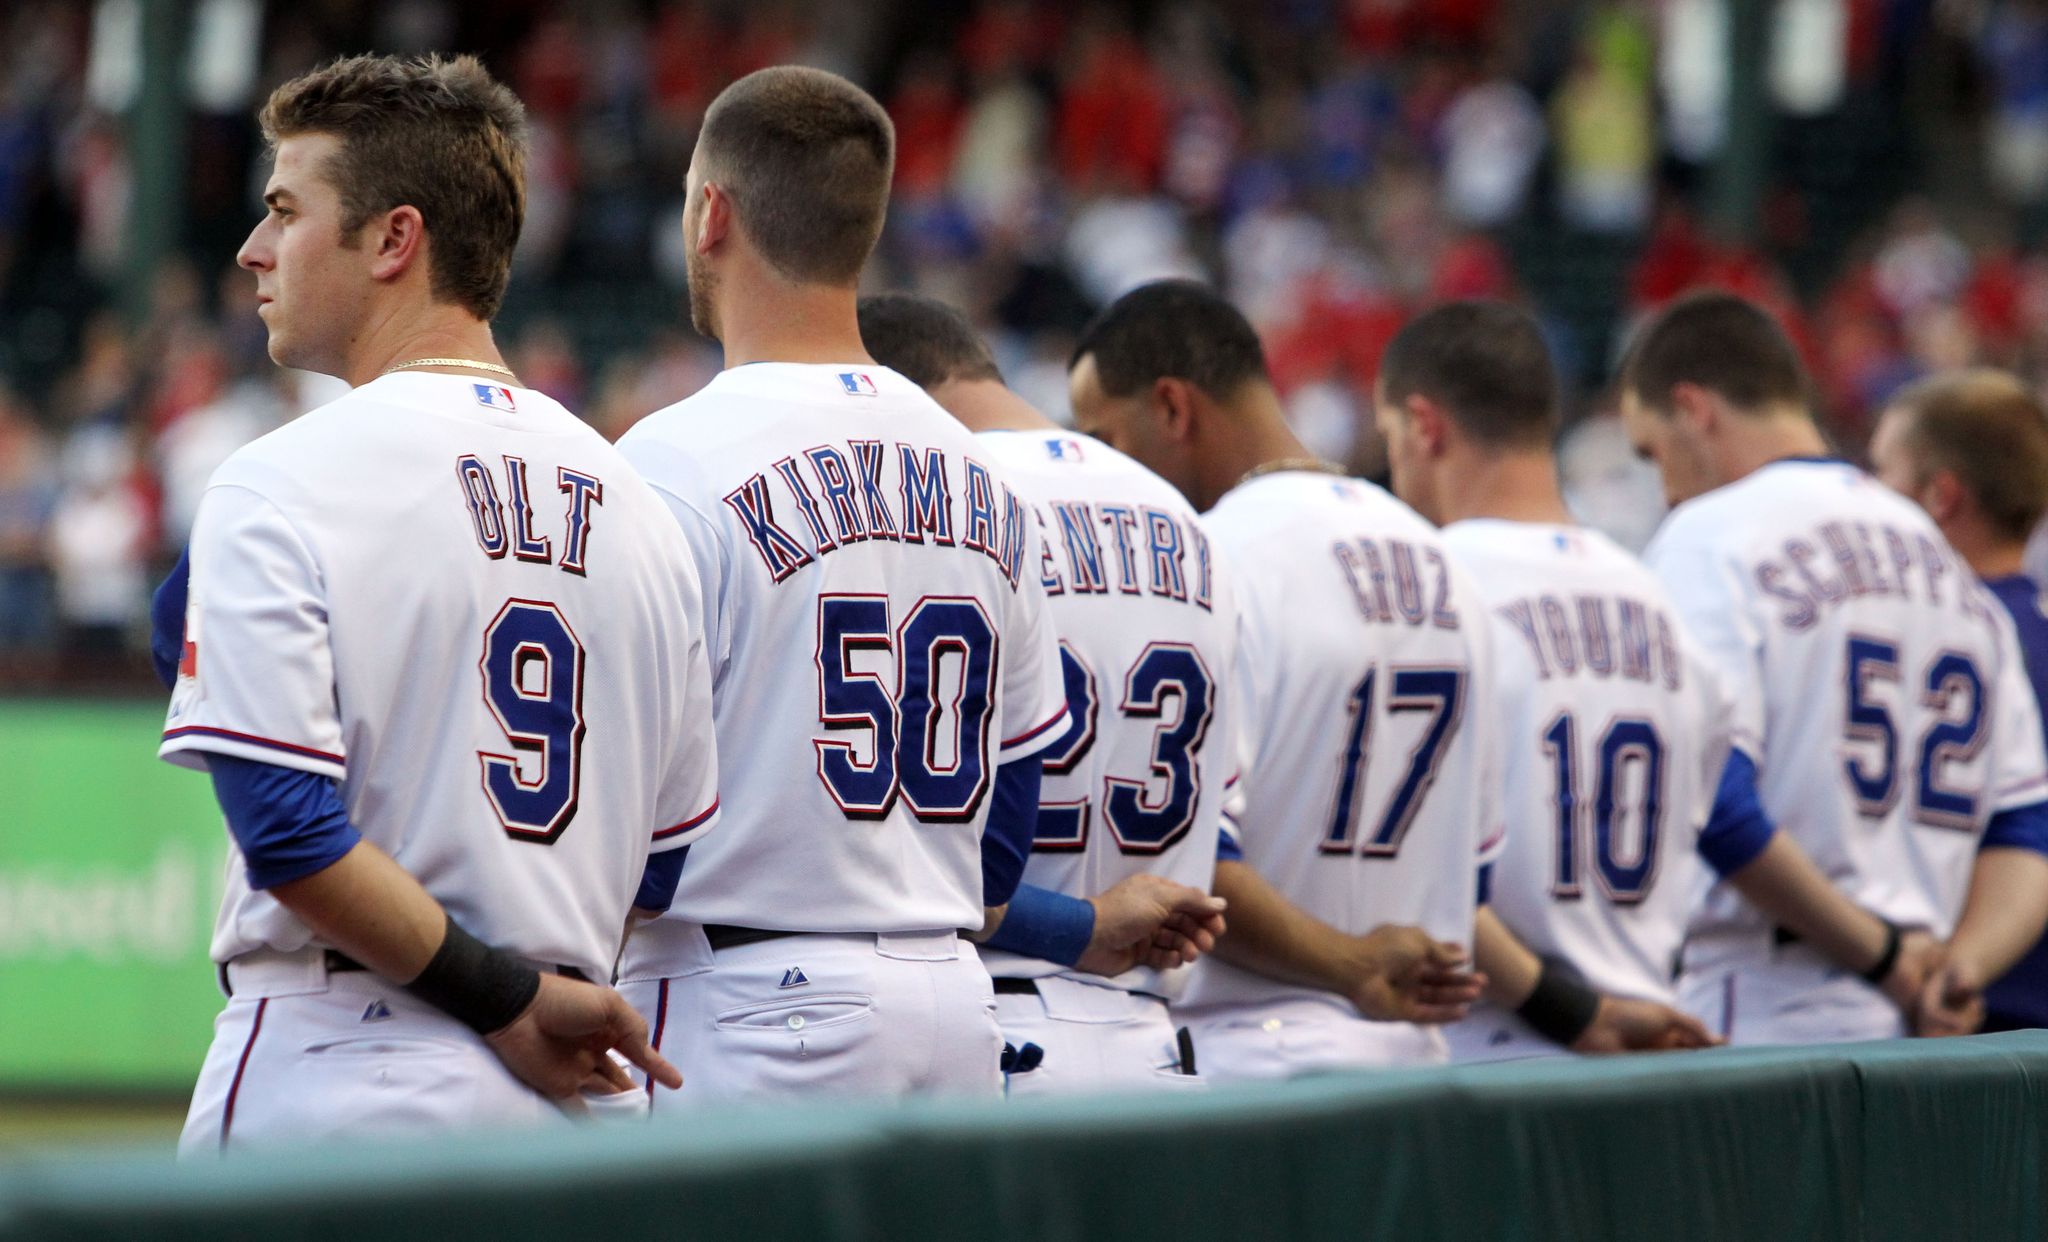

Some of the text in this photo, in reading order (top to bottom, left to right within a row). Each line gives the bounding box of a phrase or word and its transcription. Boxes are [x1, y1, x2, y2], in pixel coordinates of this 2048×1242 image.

[456, 453, 603, 577] OLT
[722, 439, 1026, 593] KIRKMAN
[1332, 537, 1460, 630] CRUZ
[476, 597, 586, 845] 9
[813, 592, 1000, 823] 50
[1495, 594, 1682, 691] YOUNG
[1839, 631, 1992, 833] 52
[1317, 662, 1468, 858] 17
[1541, 708, 1668, 903] 10
